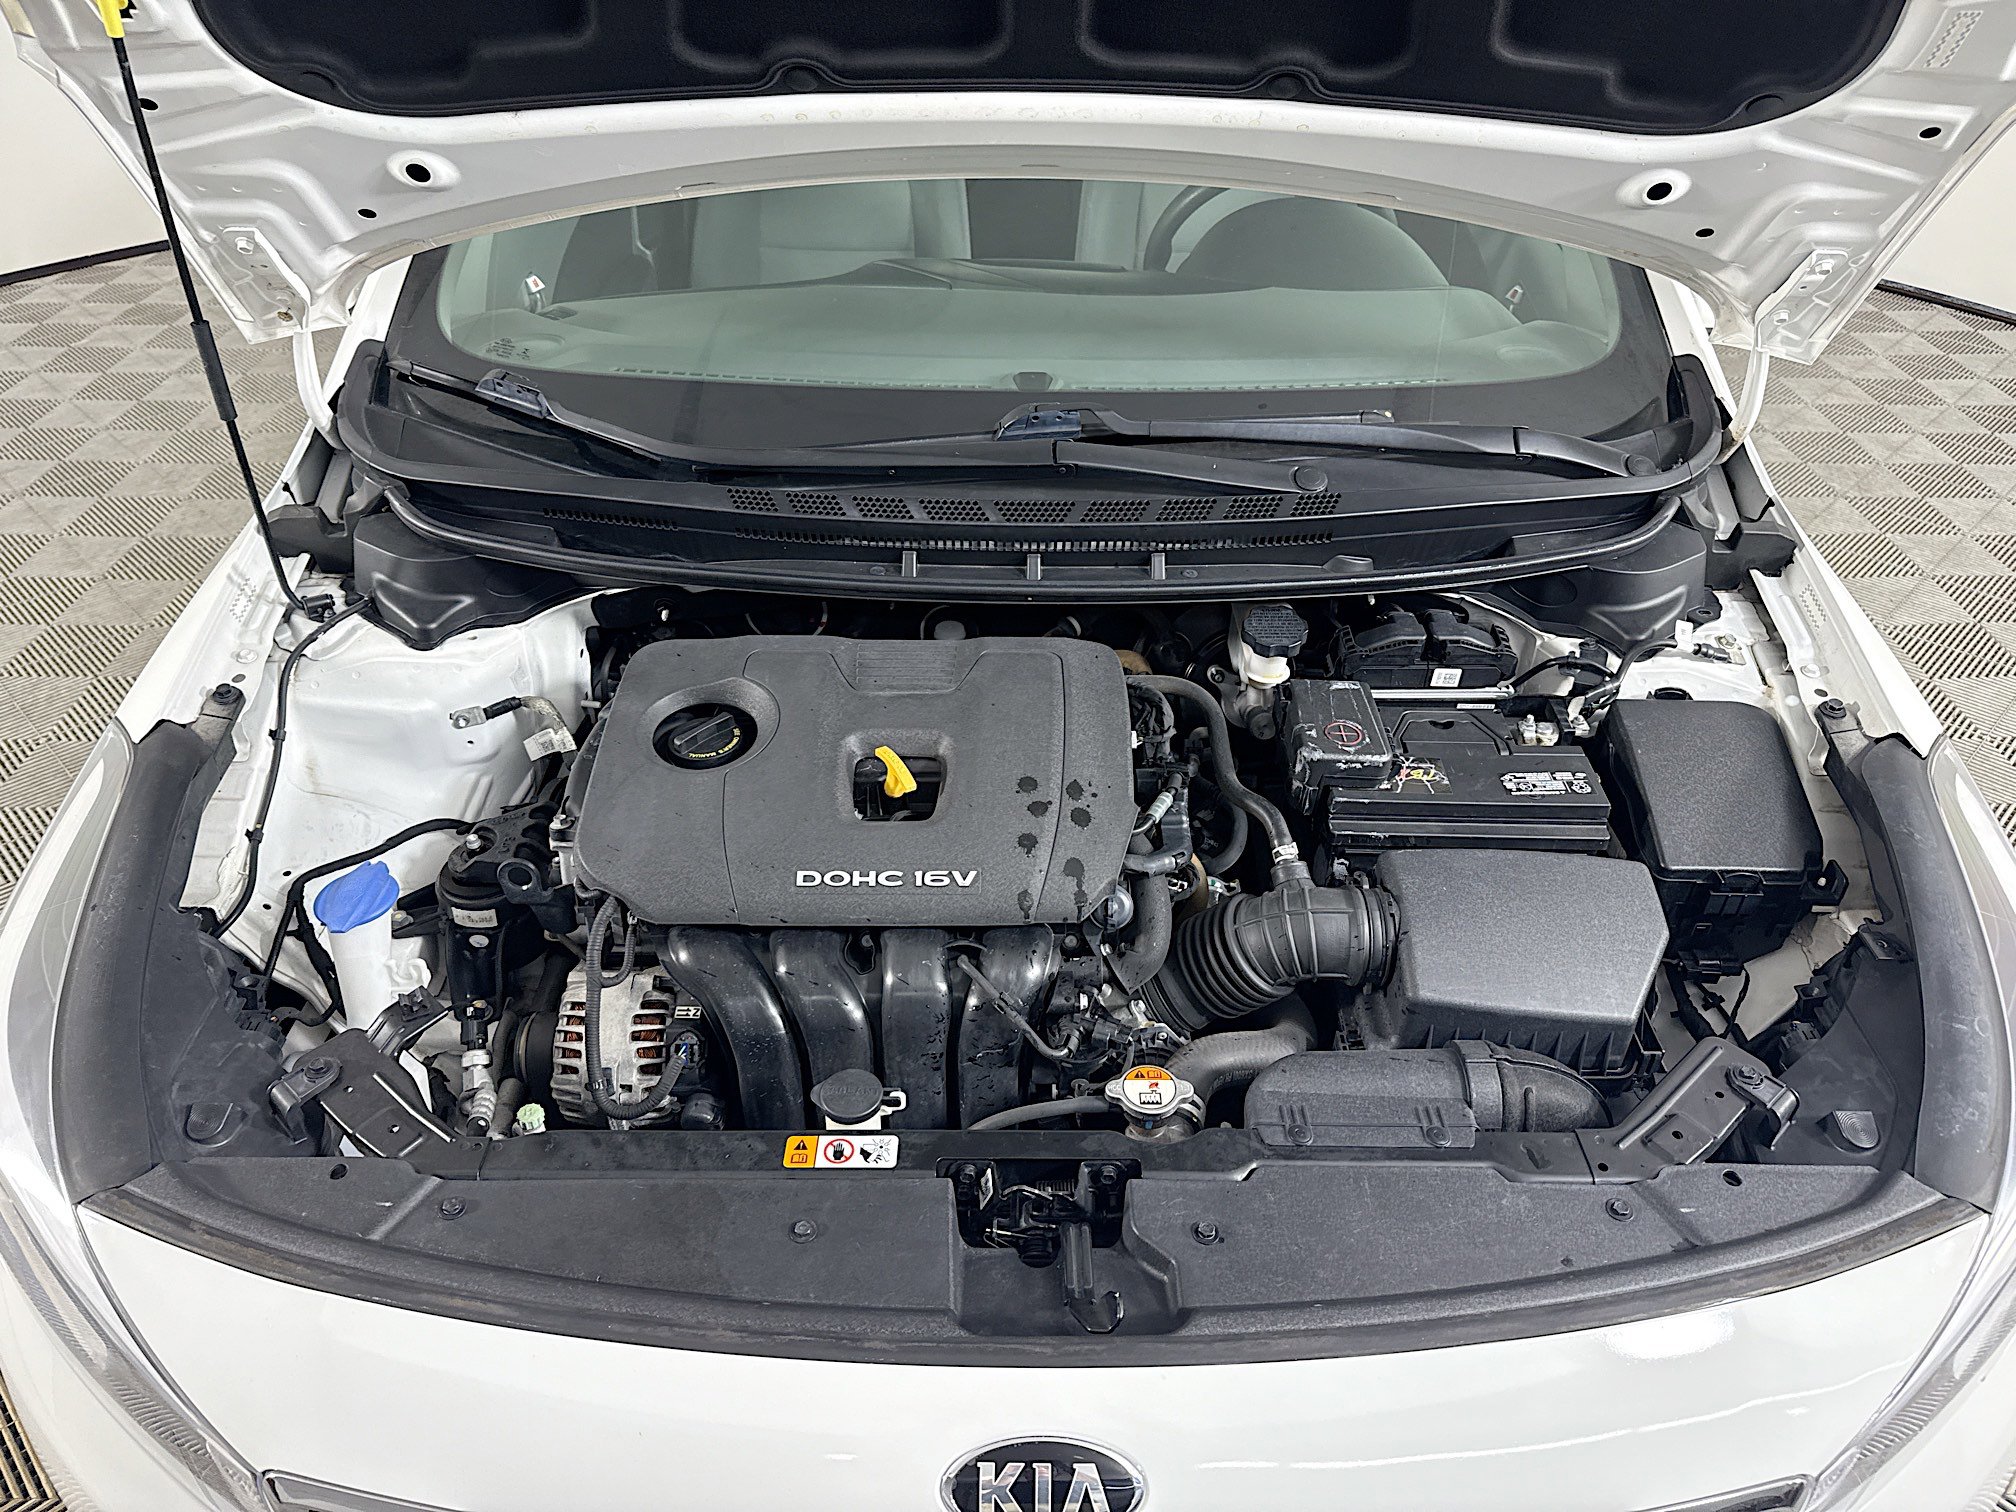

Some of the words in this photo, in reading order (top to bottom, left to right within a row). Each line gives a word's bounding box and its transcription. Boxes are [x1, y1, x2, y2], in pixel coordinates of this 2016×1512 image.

[796, 870, 904, 887] DOHC
[914, 870, 978, 887] 16V
[977, 1461, 1111, 1512] KIA
